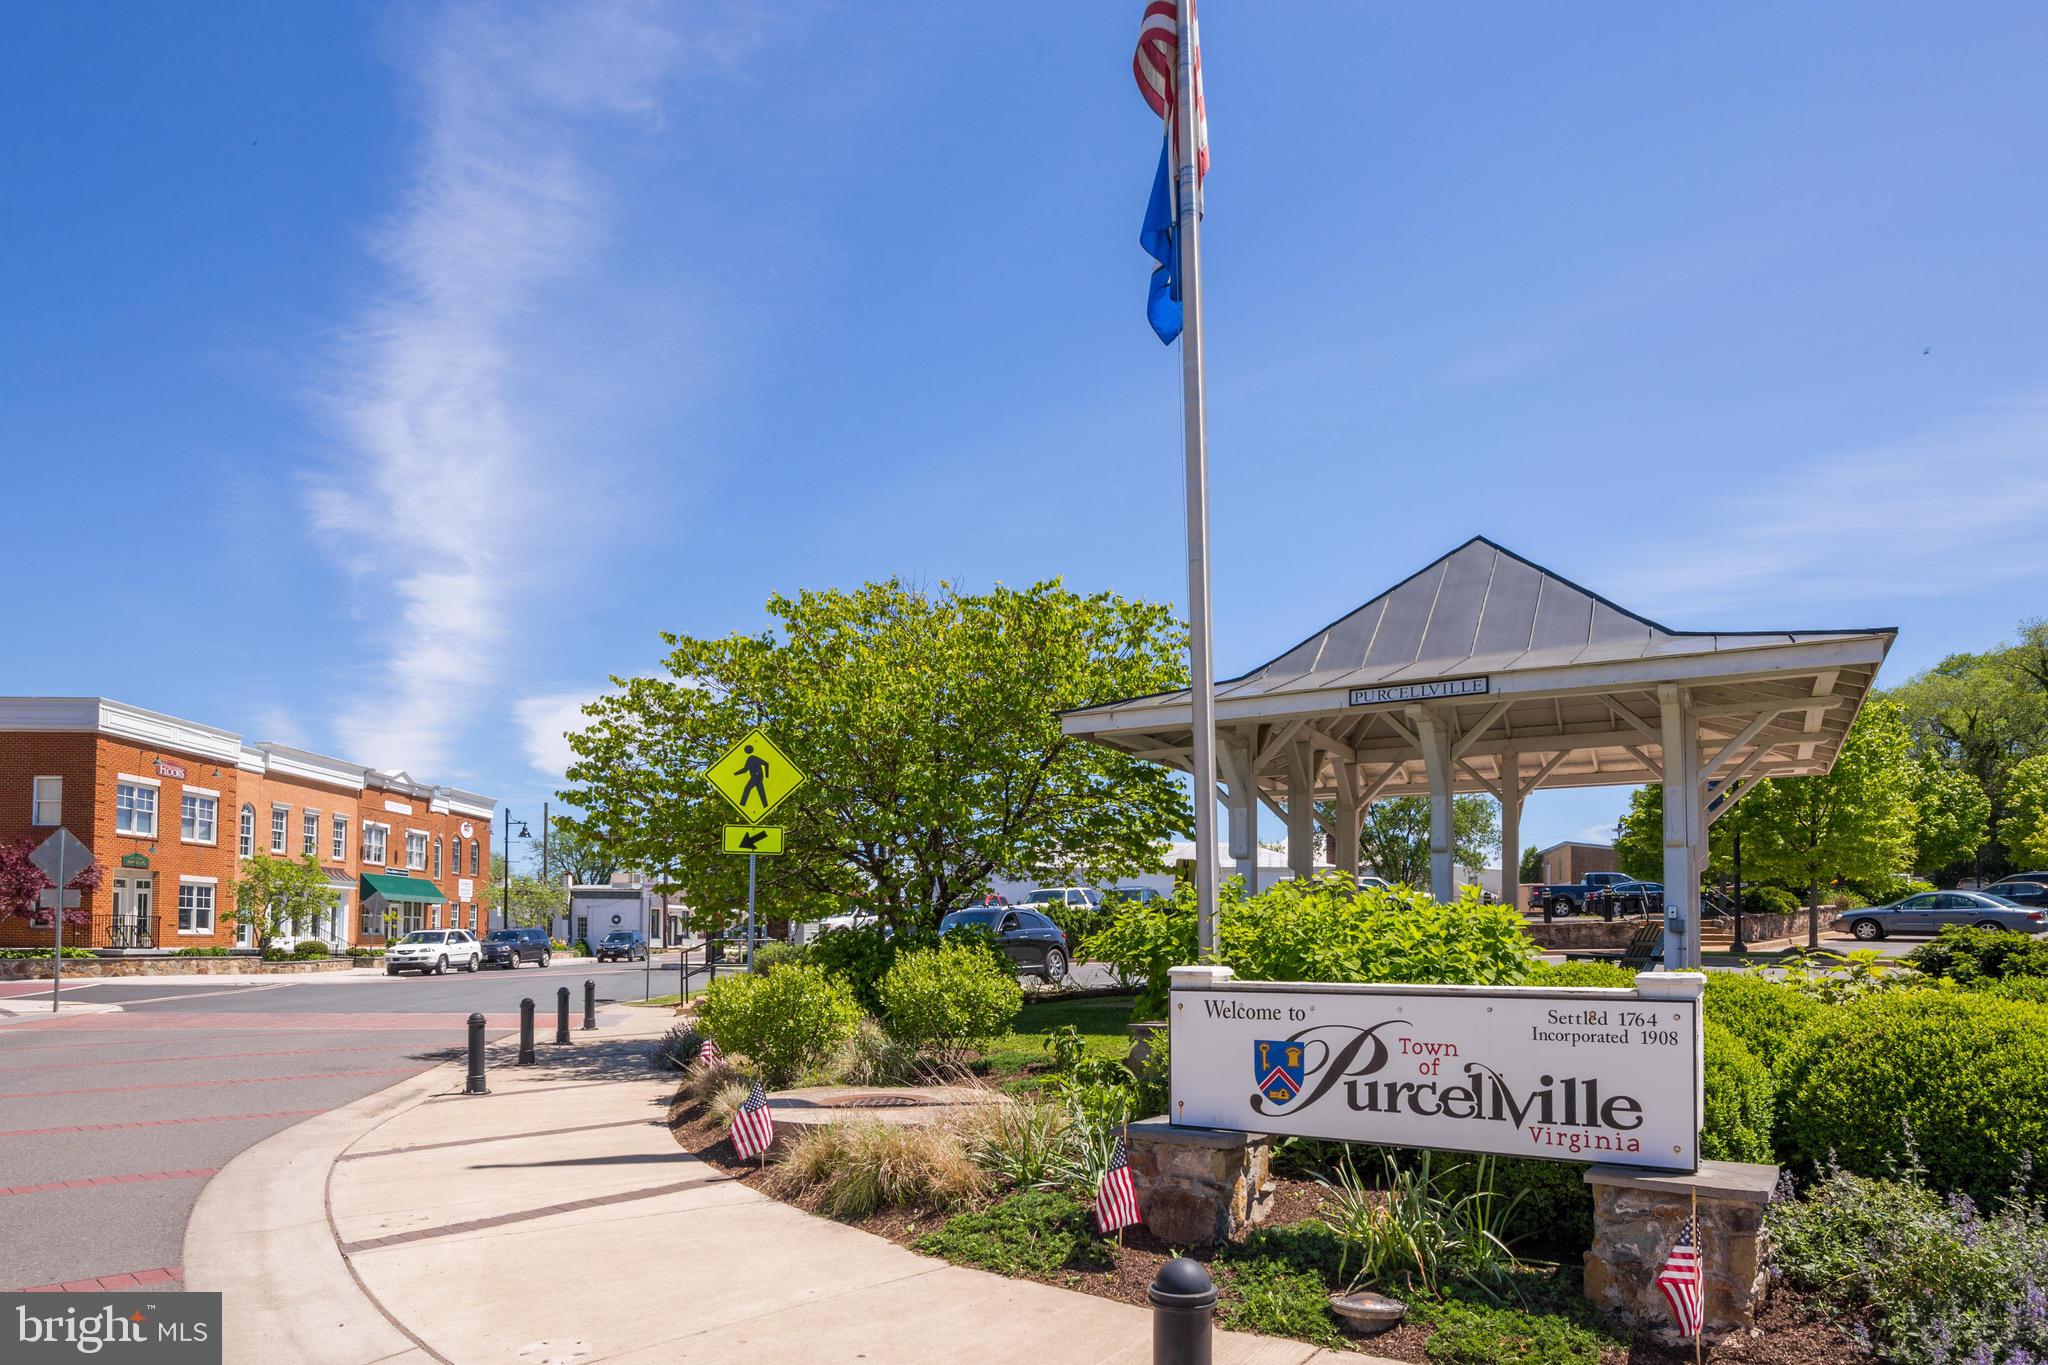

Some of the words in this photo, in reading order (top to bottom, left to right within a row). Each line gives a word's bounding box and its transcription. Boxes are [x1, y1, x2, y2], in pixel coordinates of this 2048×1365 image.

[1355, 680, 1483, 703] PURCELLVILLE
[1203, 999, 1282, 1021] Welcome
[1288, 1006, 1306, 1021] to
[1548, 1009, 1608, 1026] Settled
[1618, 1012, 1658, 1027] 1764
[1398, 1037, 1459, 1057] Town
[1531, 1026, 1629, 1047] Incorporated
[1641, 1030, 1679, 1046] 1908
[1419, 1057, 1440, 1076] of
[1528, 1127, 1641, 1153] Virginia
